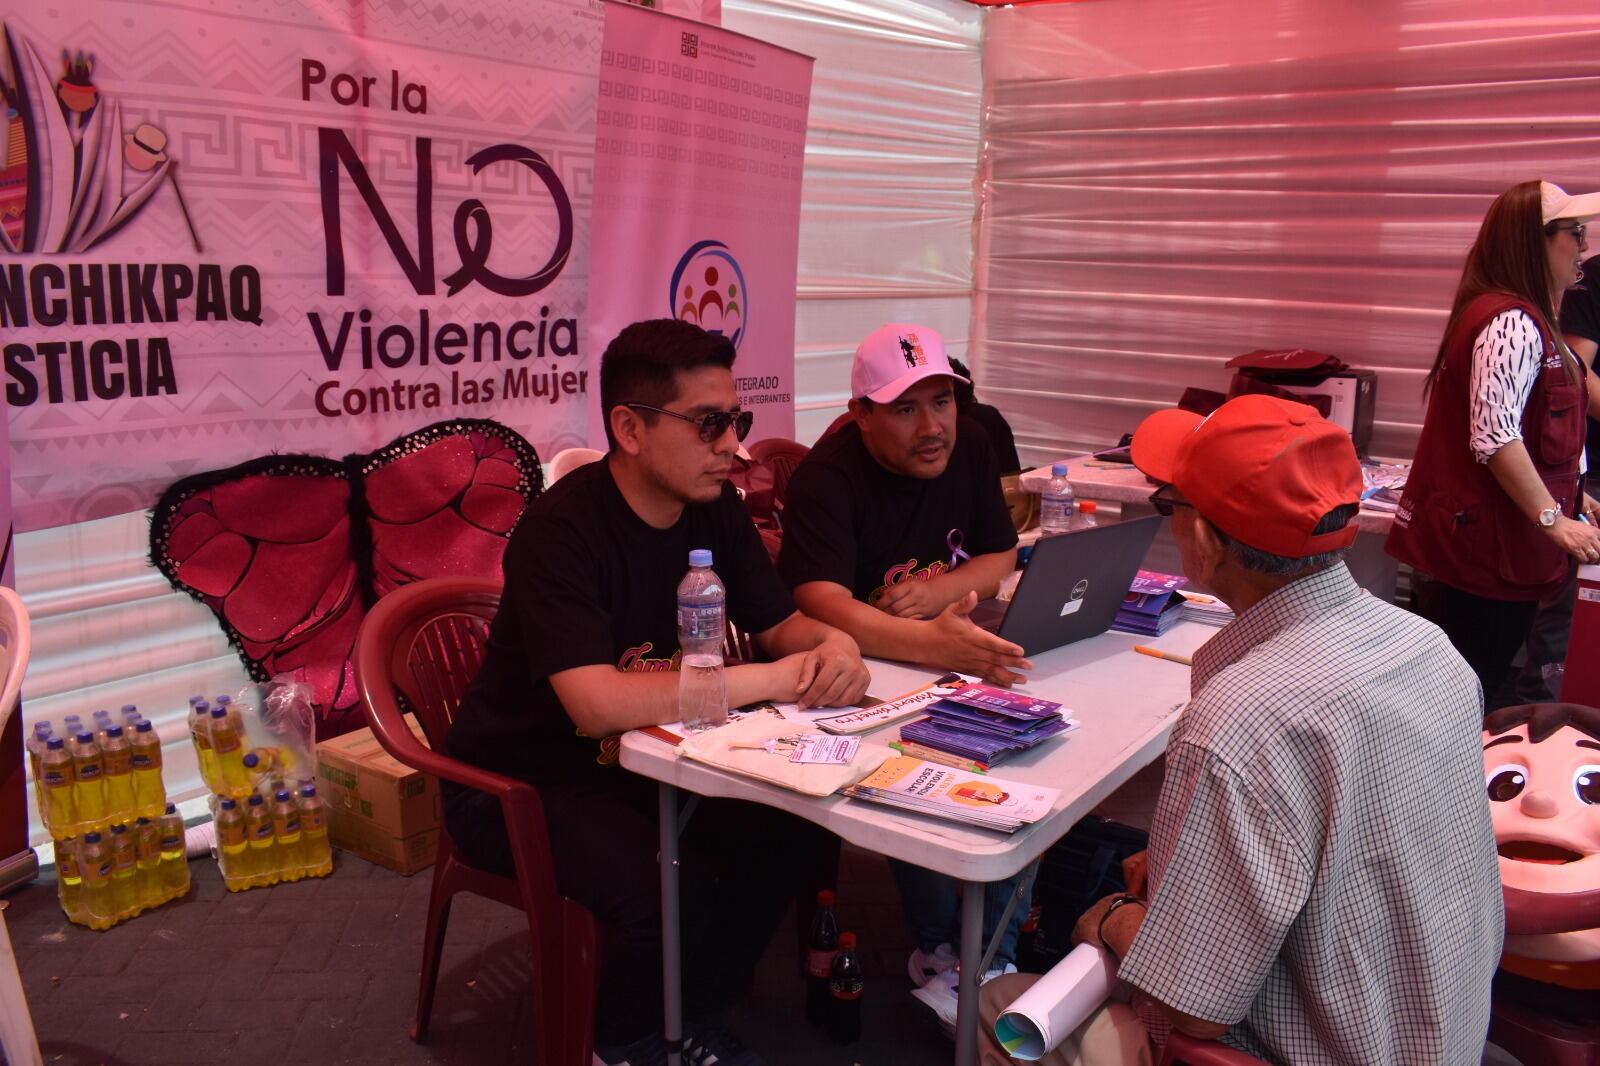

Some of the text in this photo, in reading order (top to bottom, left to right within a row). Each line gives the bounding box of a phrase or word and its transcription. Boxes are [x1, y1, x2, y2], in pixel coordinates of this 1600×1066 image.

[300, 58, 428, 115] Por la
[307, 305, 579, 372] Violencia
[3, 336, 179, 408] STICIA
[314, 376, 440, 418] Contra
[451, 372, 495, 407] las
[748, 392, 792, 405] INTEGRANTES
